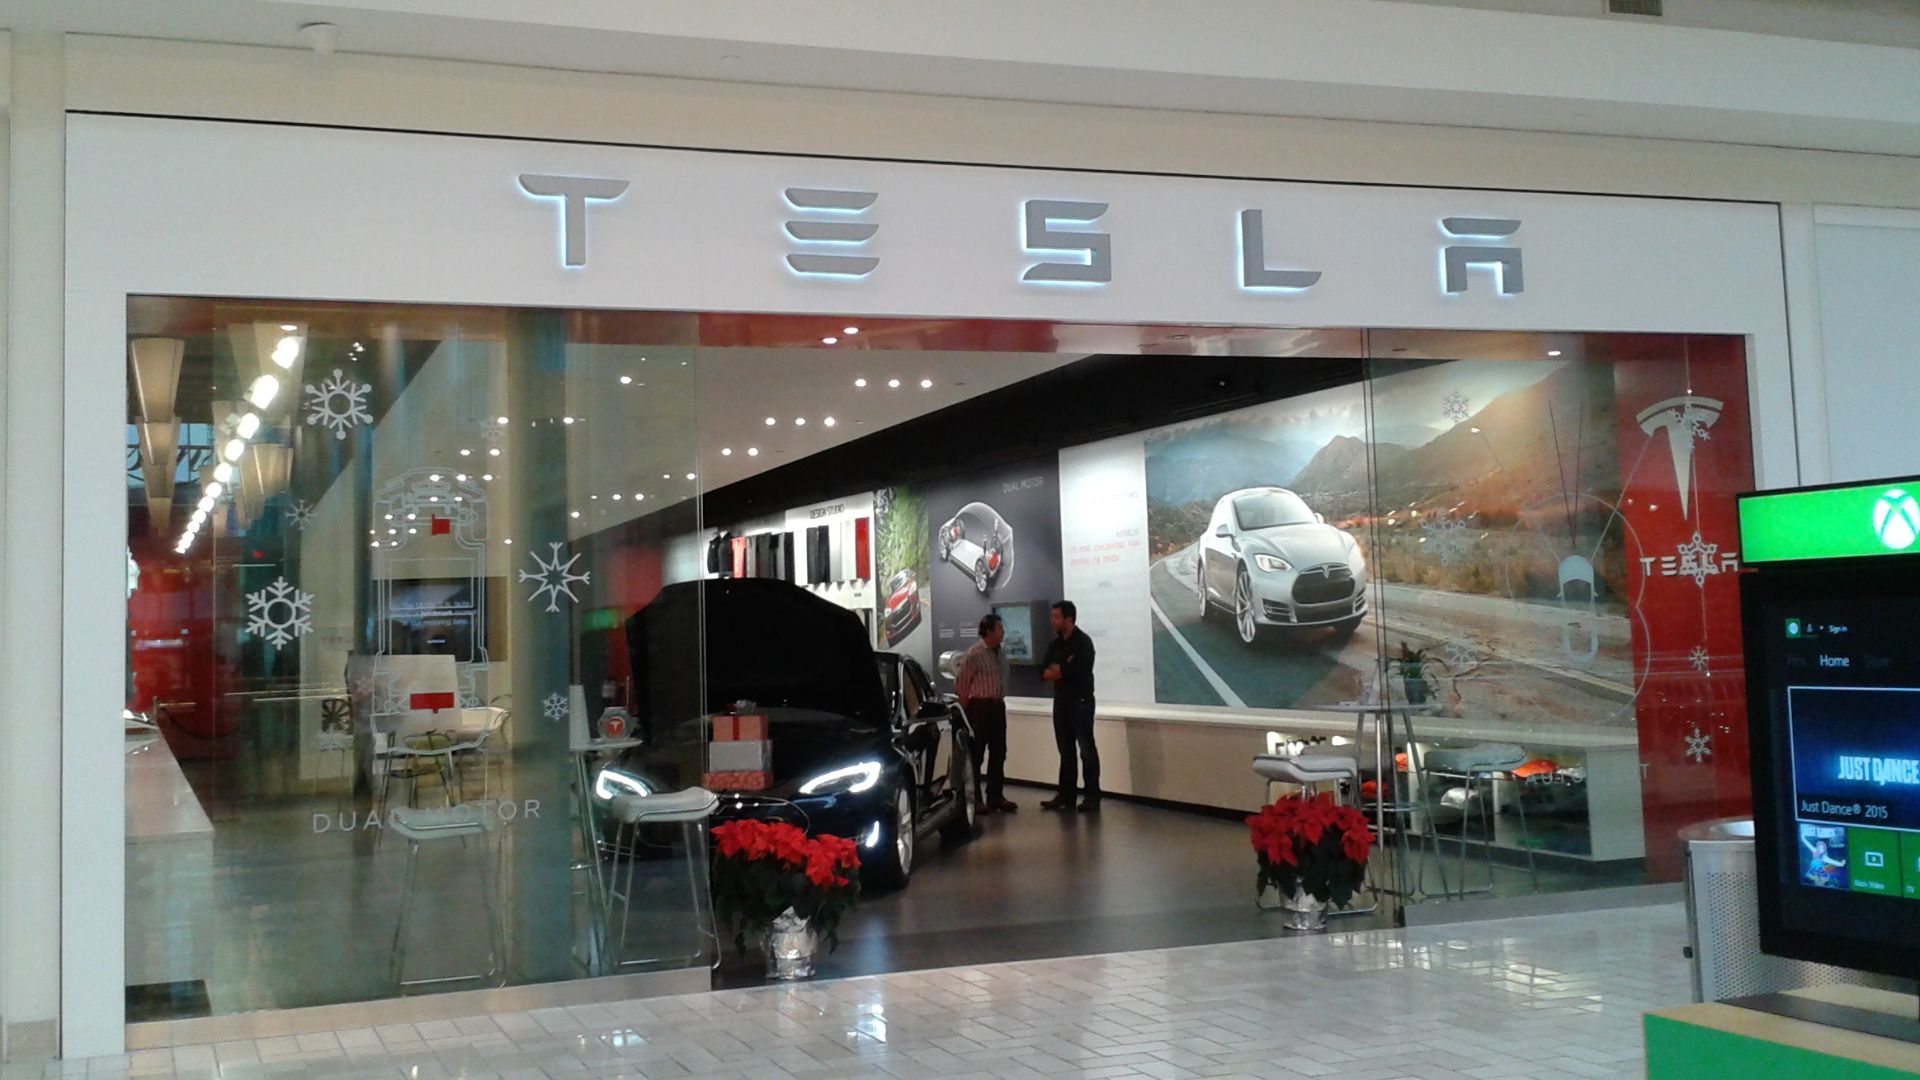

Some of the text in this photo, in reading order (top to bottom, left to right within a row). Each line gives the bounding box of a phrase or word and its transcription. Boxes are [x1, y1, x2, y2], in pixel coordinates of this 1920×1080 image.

[518, 172, 1524, 295] TESLA
[1003, 476, 1044, 493] DUAL MOTOR
[1640, 552, 1738, 576] TESLA
[1820, 655, 1850, 667] Home
[1838, 756, 1920, 785] JUST DANCE
[1801, 800, 1819, 813] Just
[1865, 805, 1888, 819] 2015
